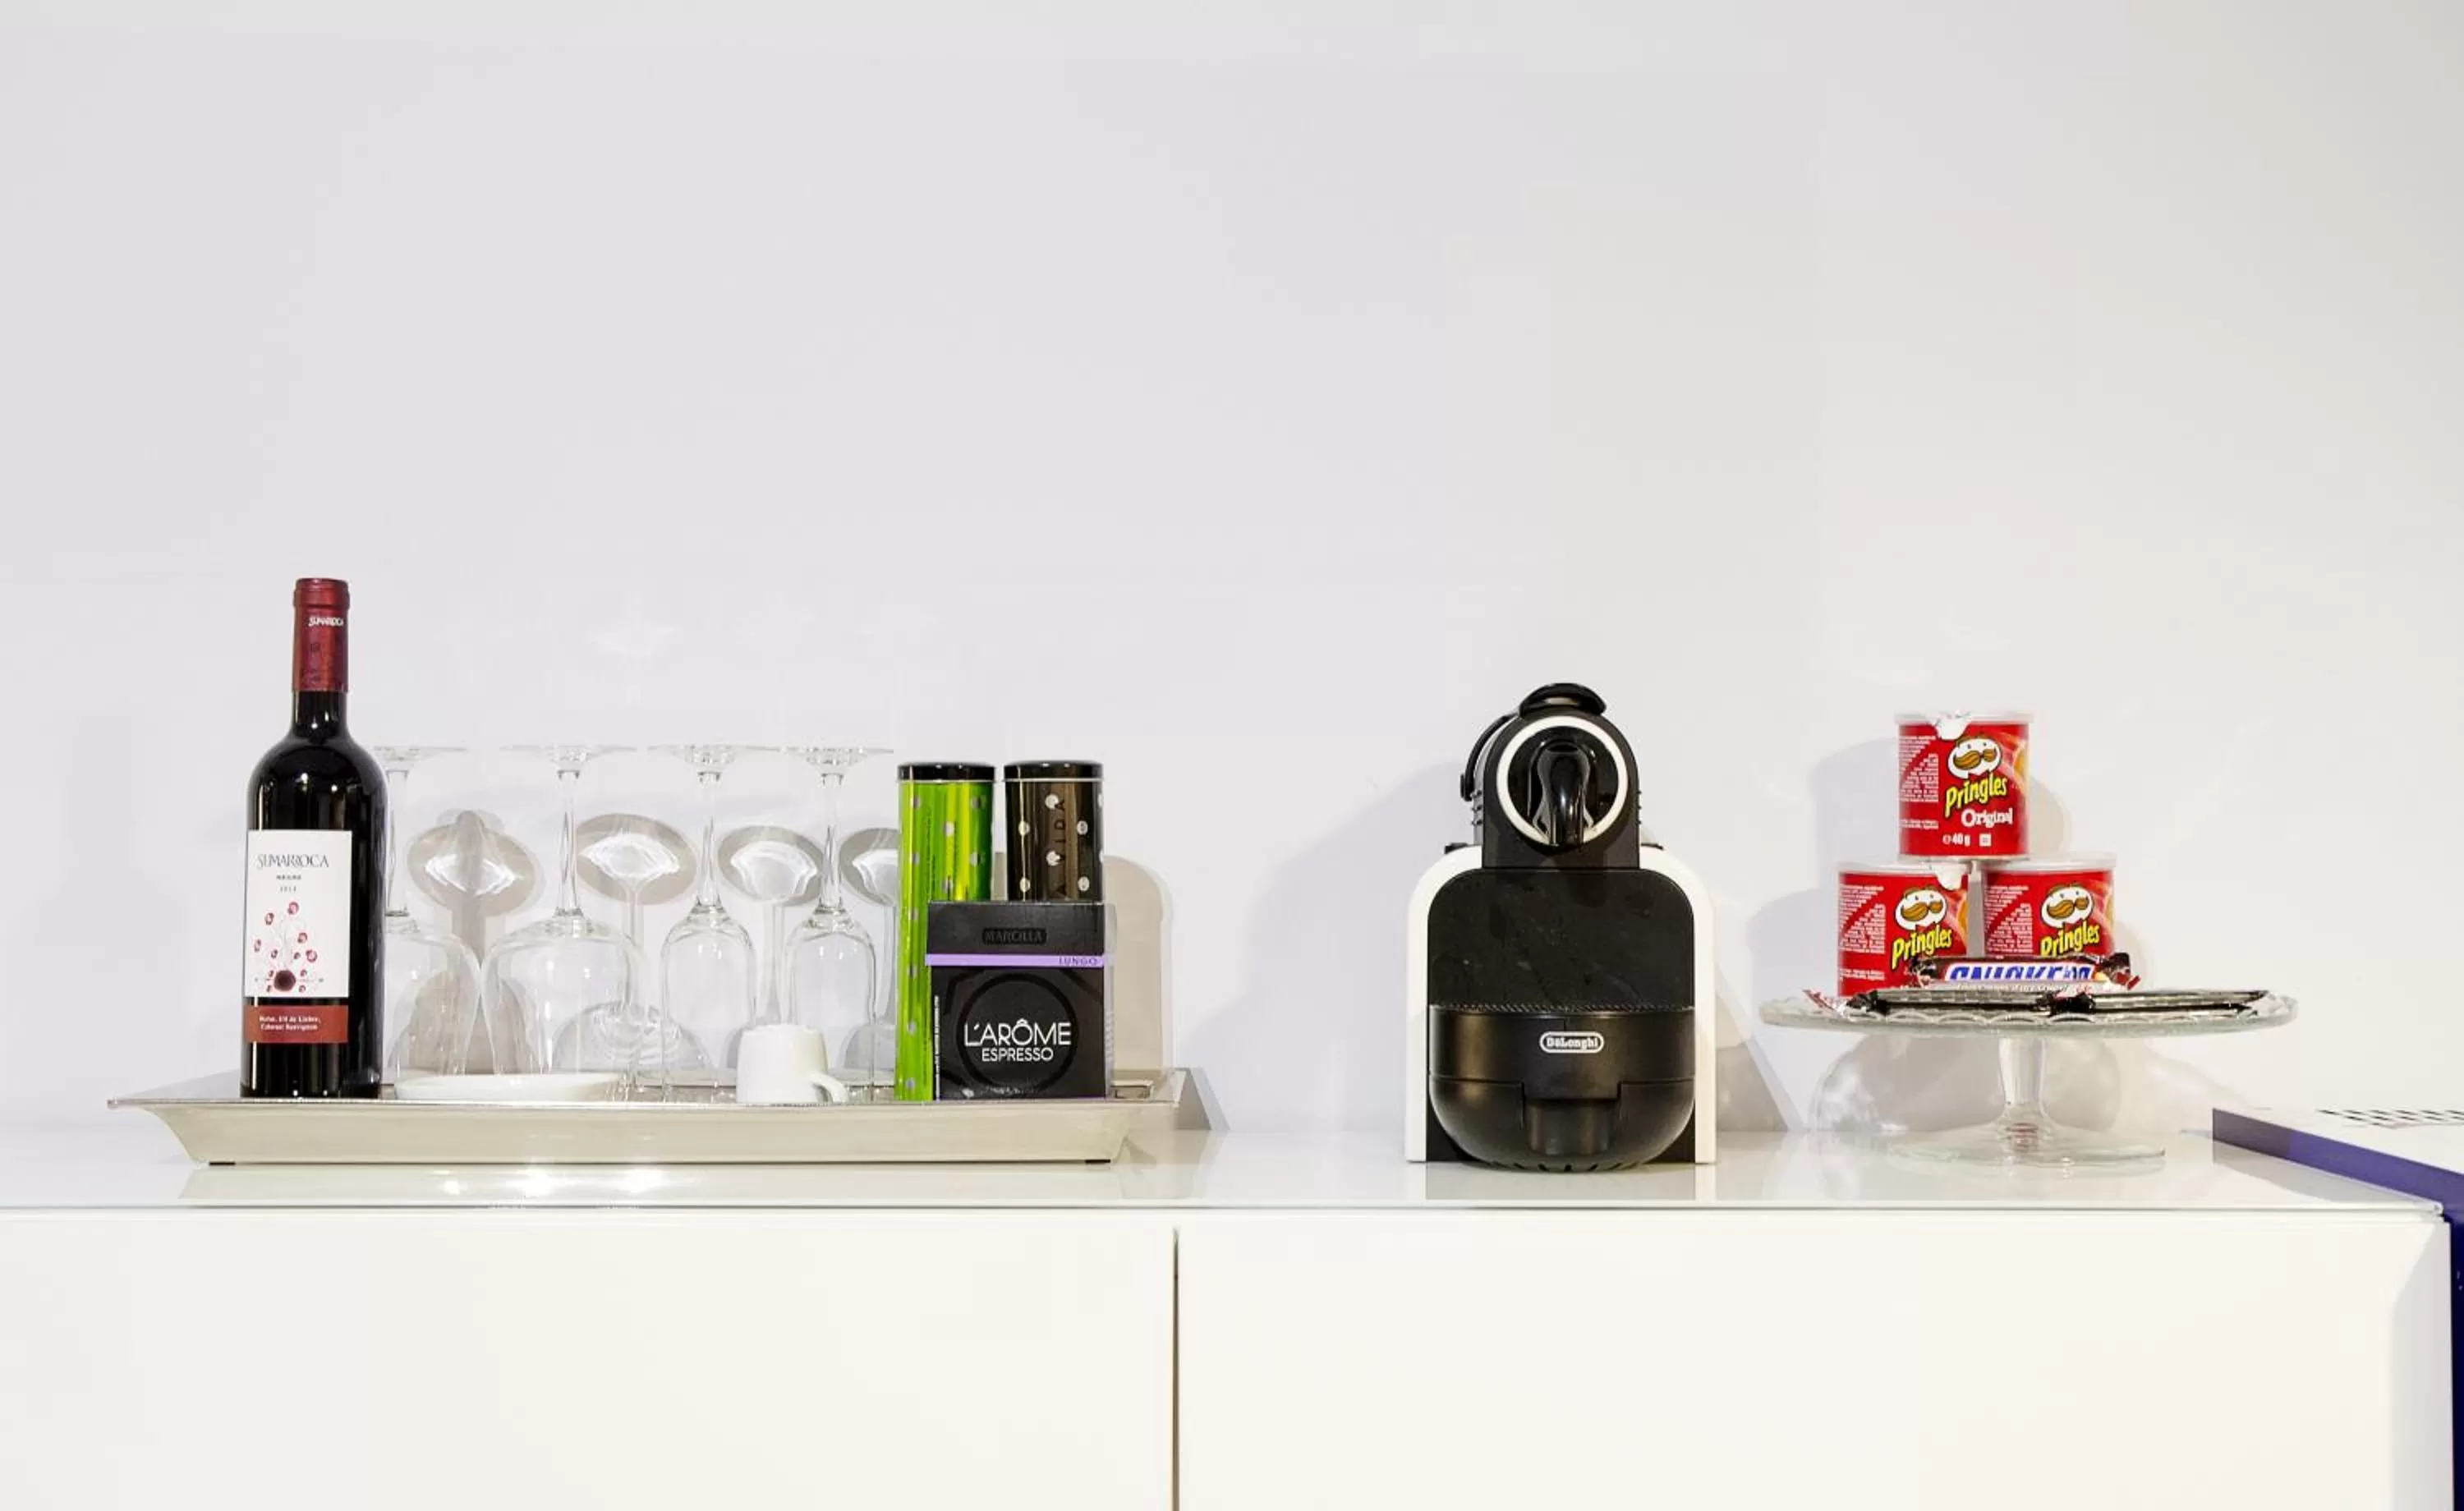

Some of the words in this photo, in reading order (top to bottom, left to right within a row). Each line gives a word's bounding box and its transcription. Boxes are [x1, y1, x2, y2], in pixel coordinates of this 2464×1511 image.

[1944, 773, 2008, 818] Pringles
[1961, 808, 2013, 827] Original
[986, 929, 1043, 942] MARCILLA
[2040, 921, 2100, 958] Pringles
[1892, 925, 1951, 970] Pringles
[1058, 956, 1098, 966] LUNGO
[1546, 1037, 1598, 1050] DeLonghi
[981, 1047, 1054, 1062] ESPRESSO
